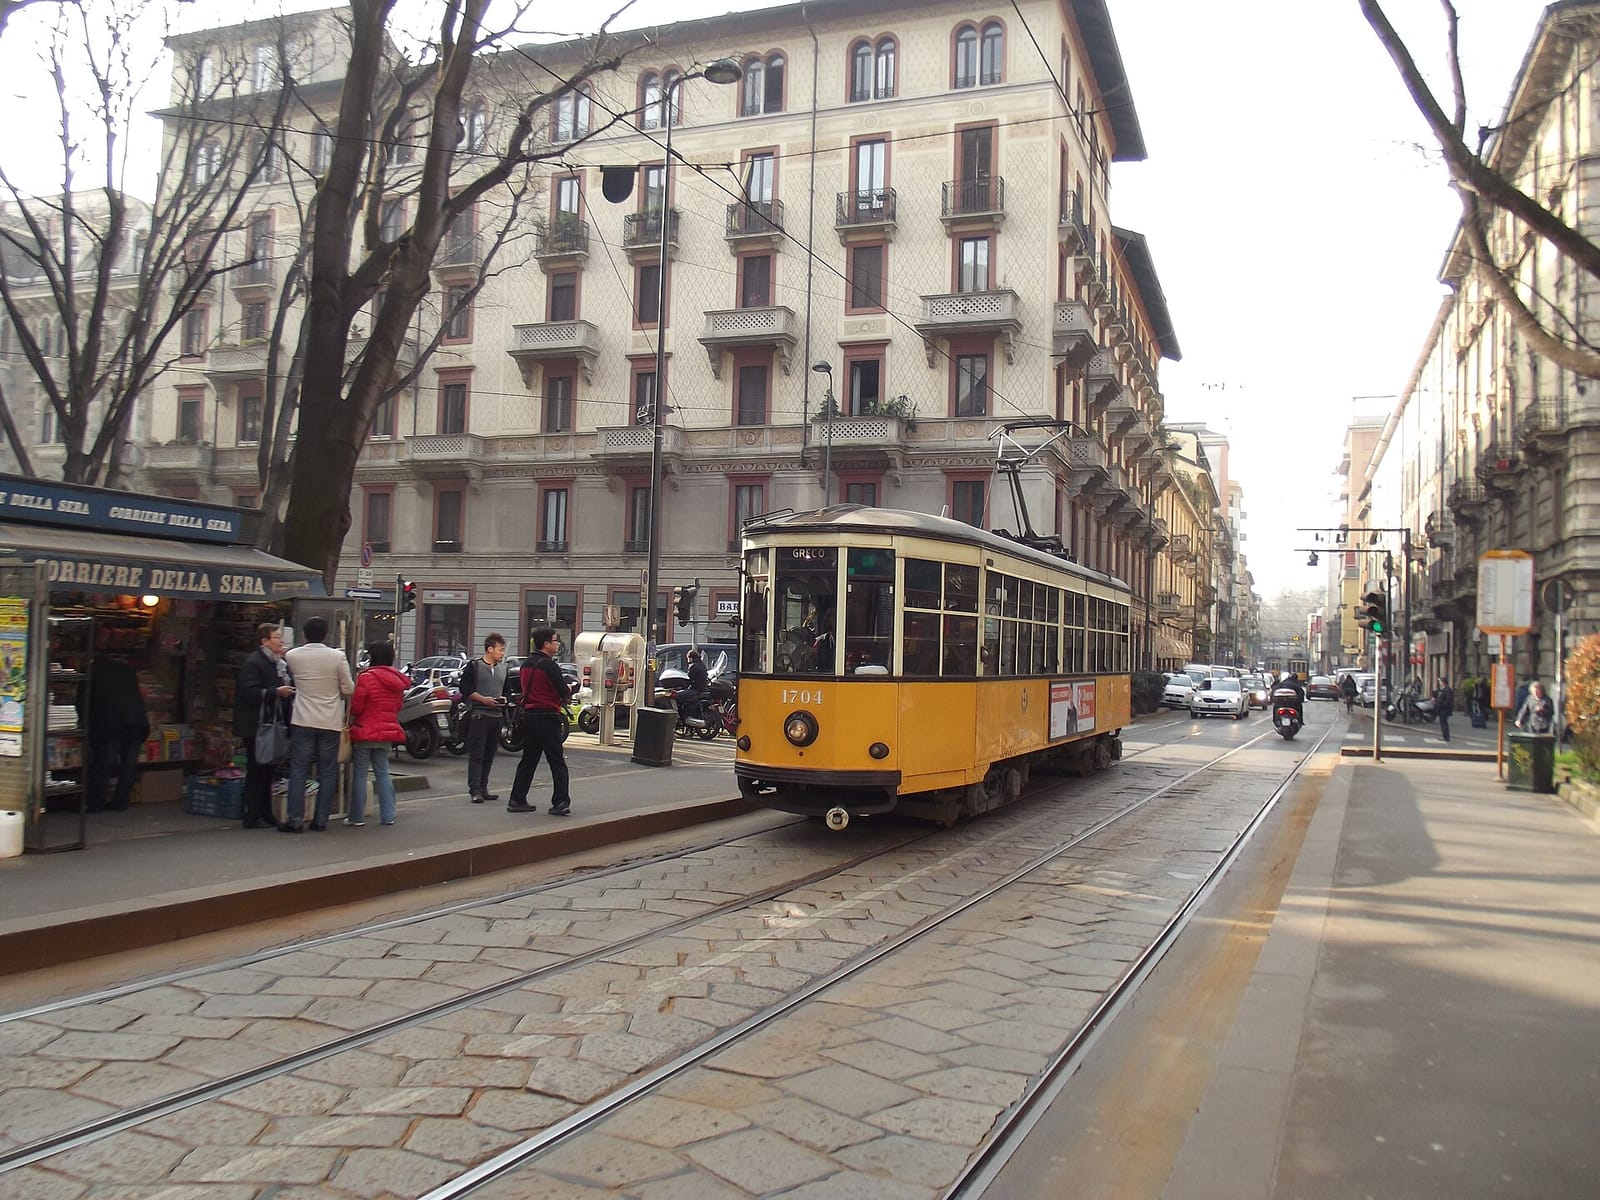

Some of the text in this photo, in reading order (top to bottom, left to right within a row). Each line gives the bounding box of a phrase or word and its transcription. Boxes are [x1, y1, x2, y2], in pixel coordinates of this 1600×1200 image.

[10, 493, 53, 510] DELLA
[57, 500, 90, 514] SERA
[109, 506, 232, 532] CORRIERE DELLA SERA
[792, 548, 825, 558] GRECO
[48, 559, 143, 588] ORRIERE
[150, 568, 211, 593] DELLA
[219, 575, 266, 596] SERA
[782, 689, 823, 705] 1704
